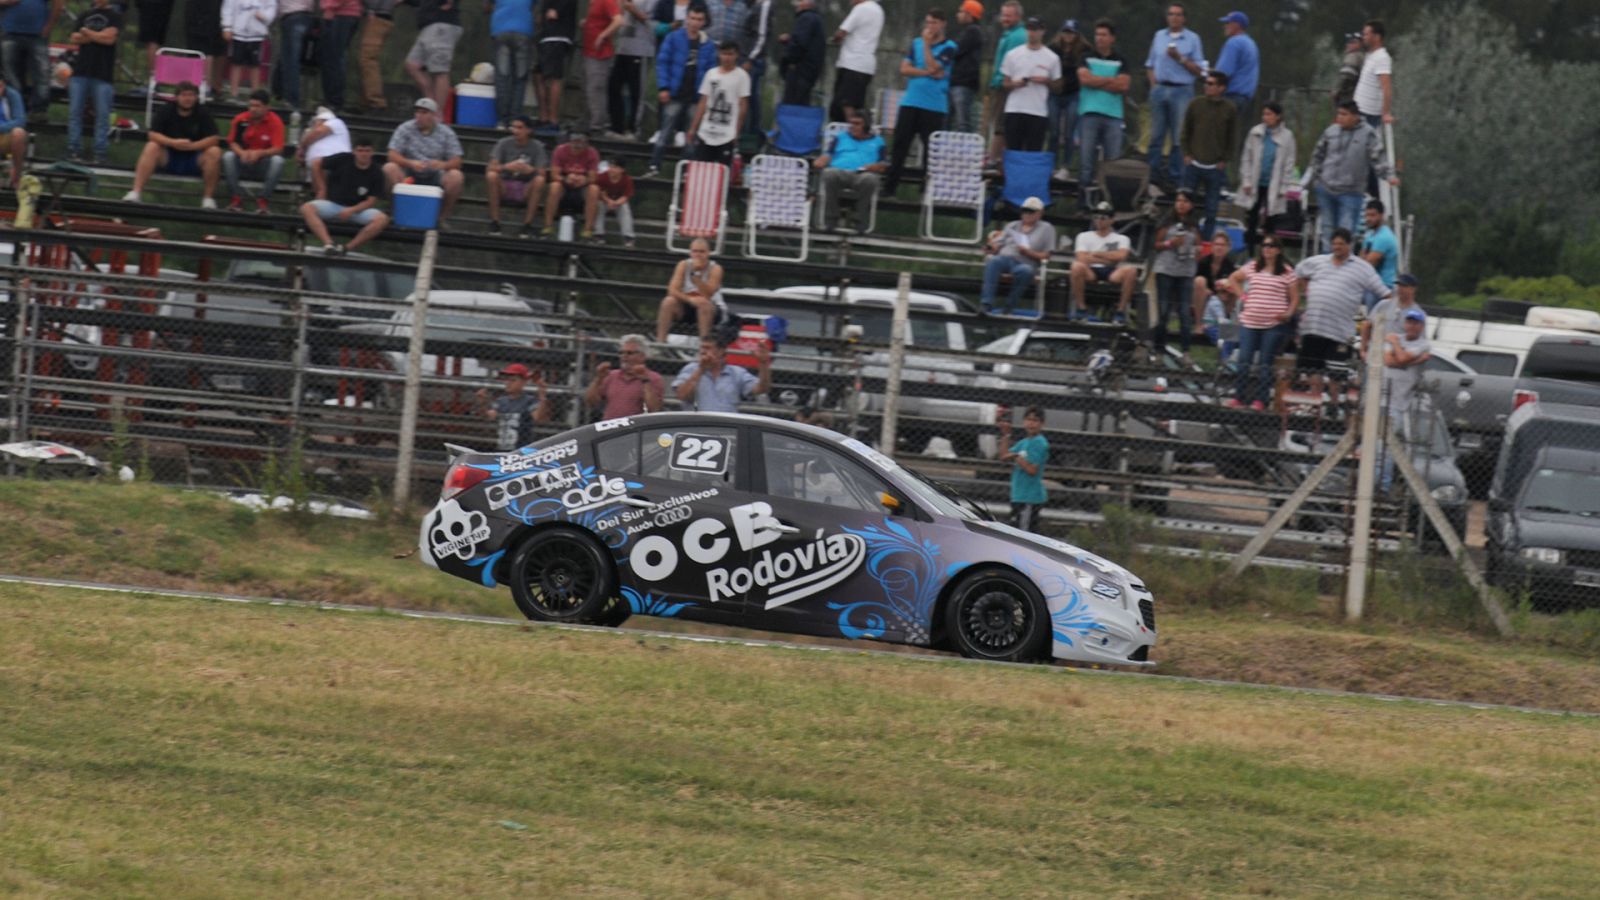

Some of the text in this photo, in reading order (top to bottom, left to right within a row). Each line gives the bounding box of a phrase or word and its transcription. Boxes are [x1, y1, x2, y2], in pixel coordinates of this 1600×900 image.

[500, 444, 578, 473] FACTORY
[677, 437, 722, 468] 22
[597, 487, 719, 531] Del Sur Exclusivos
[627, 520, 654, 535] Audi
[629, 501, 783, 582] OCB
[706, 528, 848, 602] Rodovía
